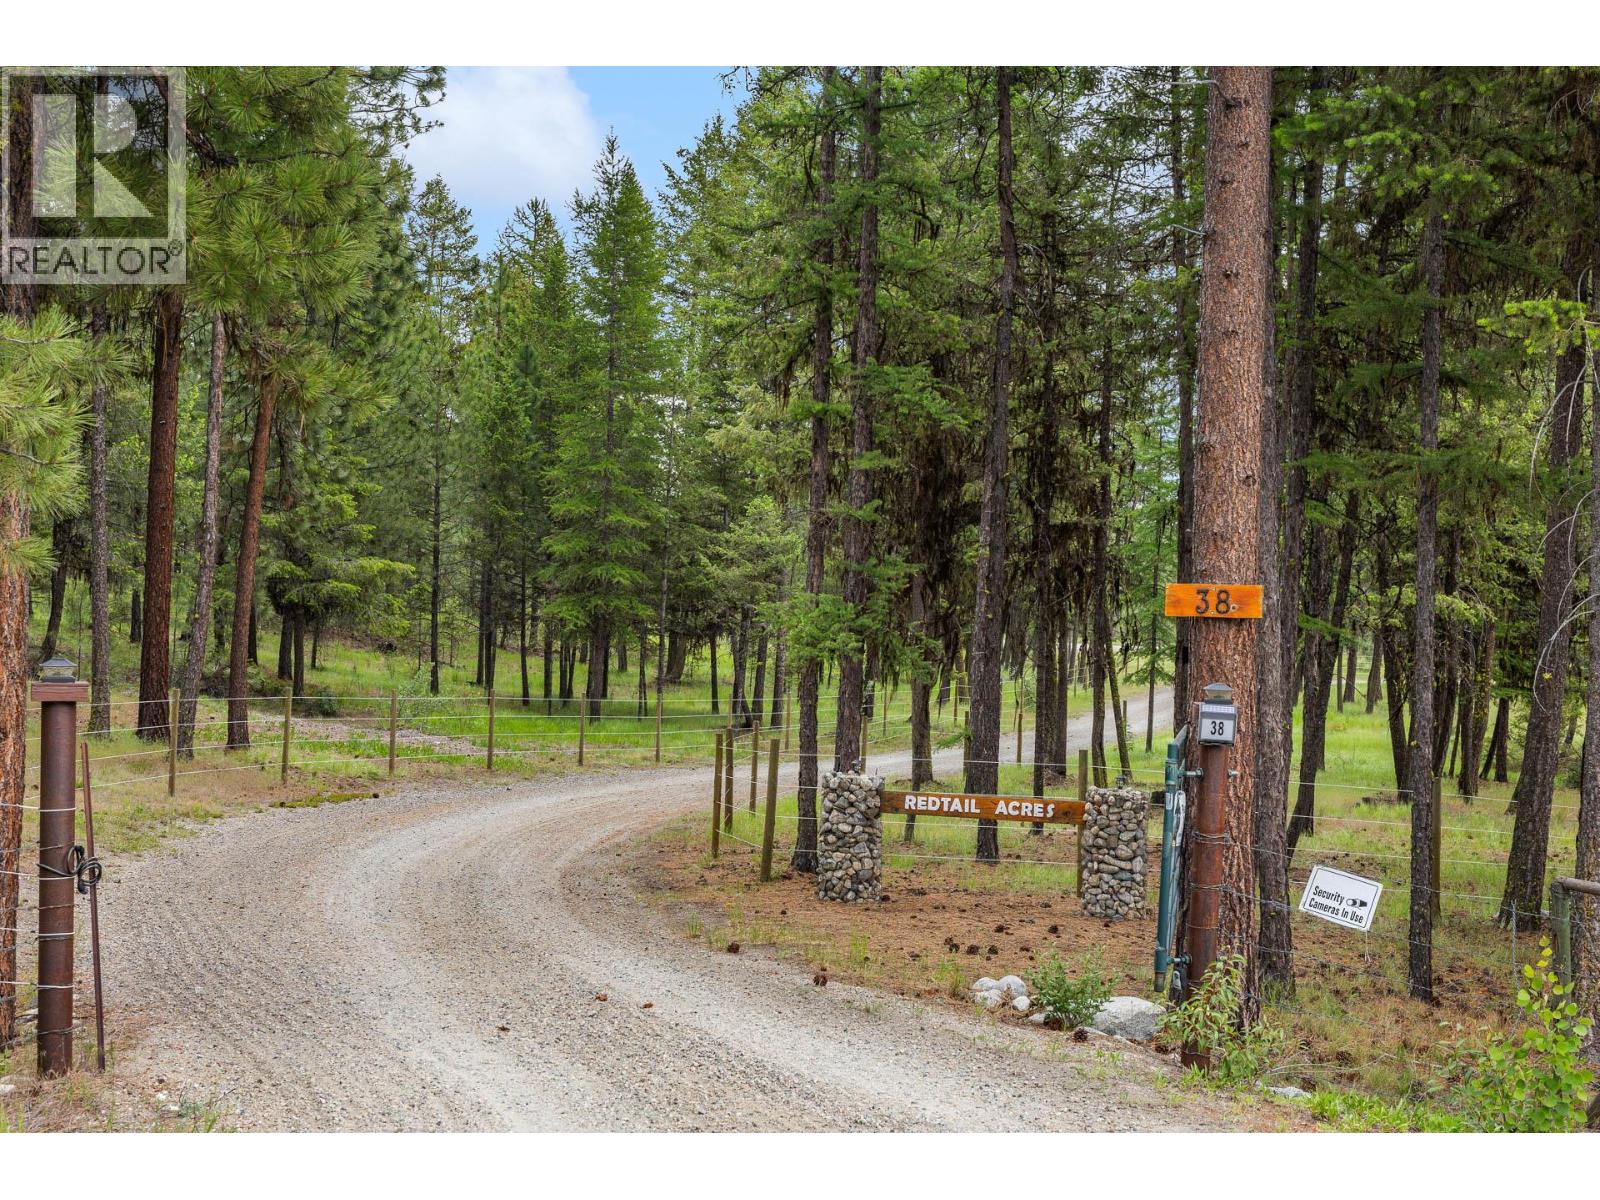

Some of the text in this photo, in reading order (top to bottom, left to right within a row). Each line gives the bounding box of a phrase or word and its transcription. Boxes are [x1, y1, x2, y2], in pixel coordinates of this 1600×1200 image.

[1195, 588, 1231, 615] 38
[1210, 720, 1225, 736] 38
[904, 794, 1056, 818] REDTAIL ACRES
[1312, 885, 1345, 906] Security
[1308, 897, 1364, 924] Cameras In Use
